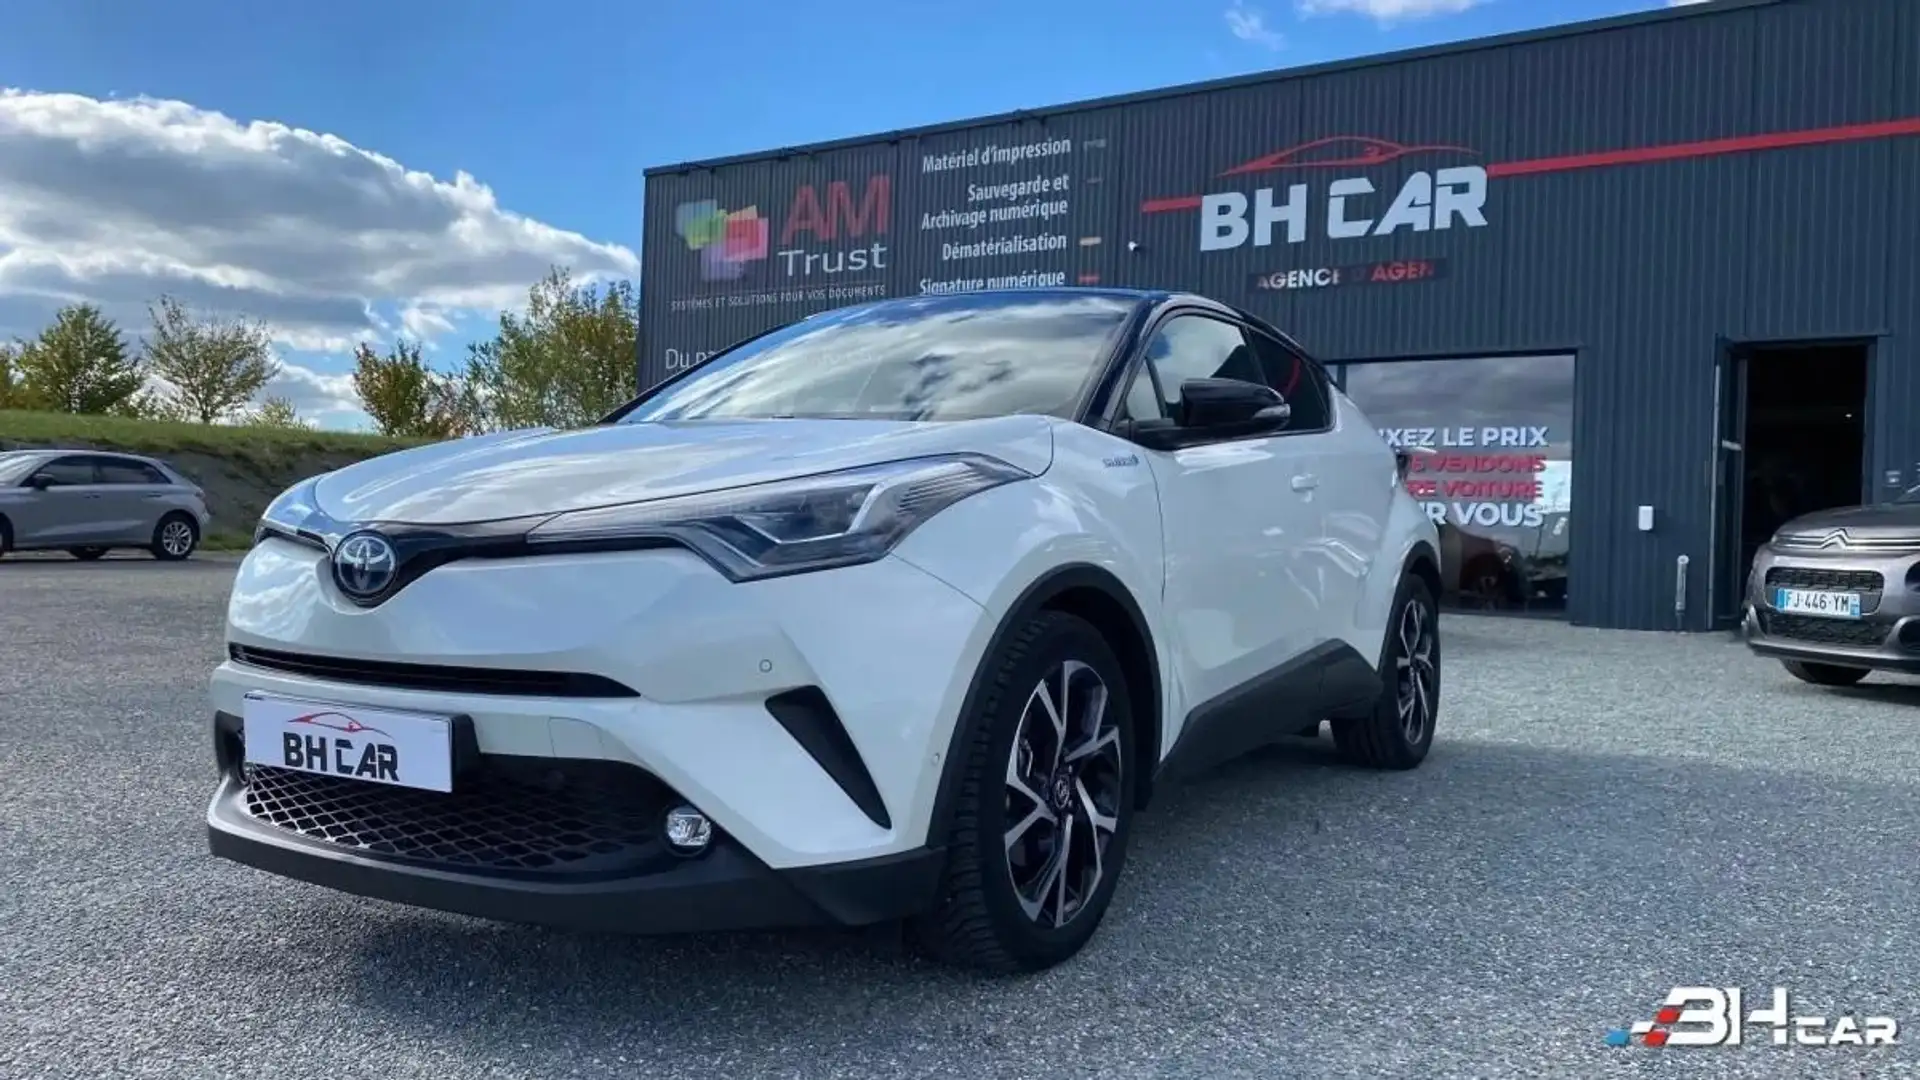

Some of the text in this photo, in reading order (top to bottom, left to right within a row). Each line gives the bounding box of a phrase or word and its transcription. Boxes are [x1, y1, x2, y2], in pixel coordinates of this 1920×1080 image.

[923, 137, 1071, 173] Matériel d'impression
[968, 174, 1069, 202] Sauvegarde et
[780, 175, 890, 246] AM
[922, 199, 1068, 230] Archivage numérique
[1200, 165, 1488, 252] BH CAR
[778, 243, 888, 277] Trust
[942, 232, 1067, 261] Dématérialisation
[780, 290, 804, 302] POUR
[829, 284, 886, 298] DOCUMENTS
[919, 270, 1066, 296] Signature numérique
[665, 348, 690, 370] Du
[1378, 426, 1549, 447] XEZ LE PRIX
[1431, 454, 1547, 473] VENDONS
[1442, 479, 1544, 498] VOITURE
[1453, 501, 1544, 527] VOUS
[283, 731, 400, 782] BH CAR
